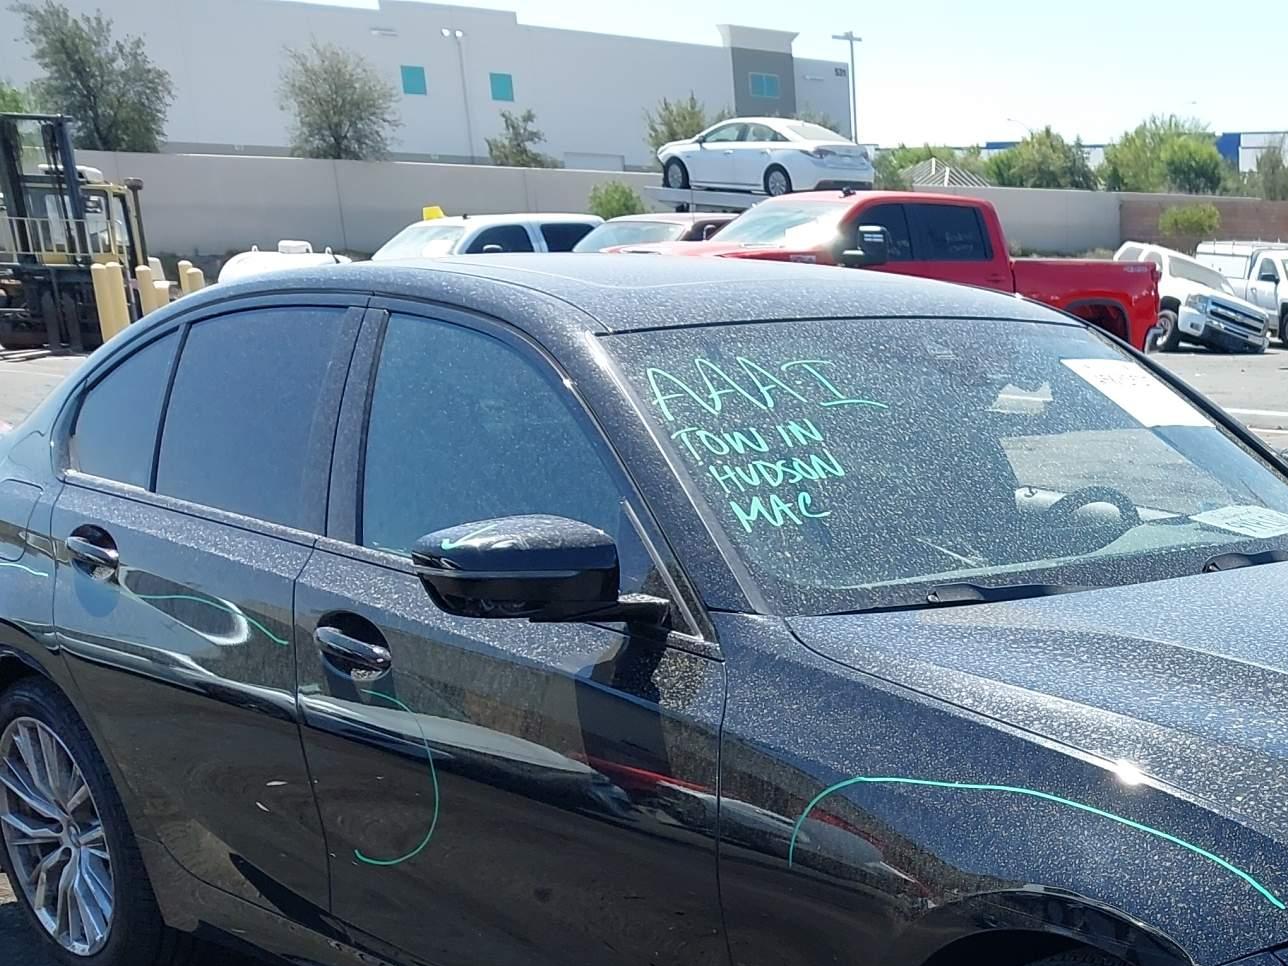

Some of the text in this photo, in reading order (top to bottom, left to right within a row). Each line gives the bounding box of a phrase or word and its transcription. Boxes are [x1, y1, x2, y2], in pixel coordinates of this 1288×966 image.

[670, 418, 824, 466] TOW IN
[708, 448, 846, 494] HUDSON
[729, 491, 831, 534] MAC
